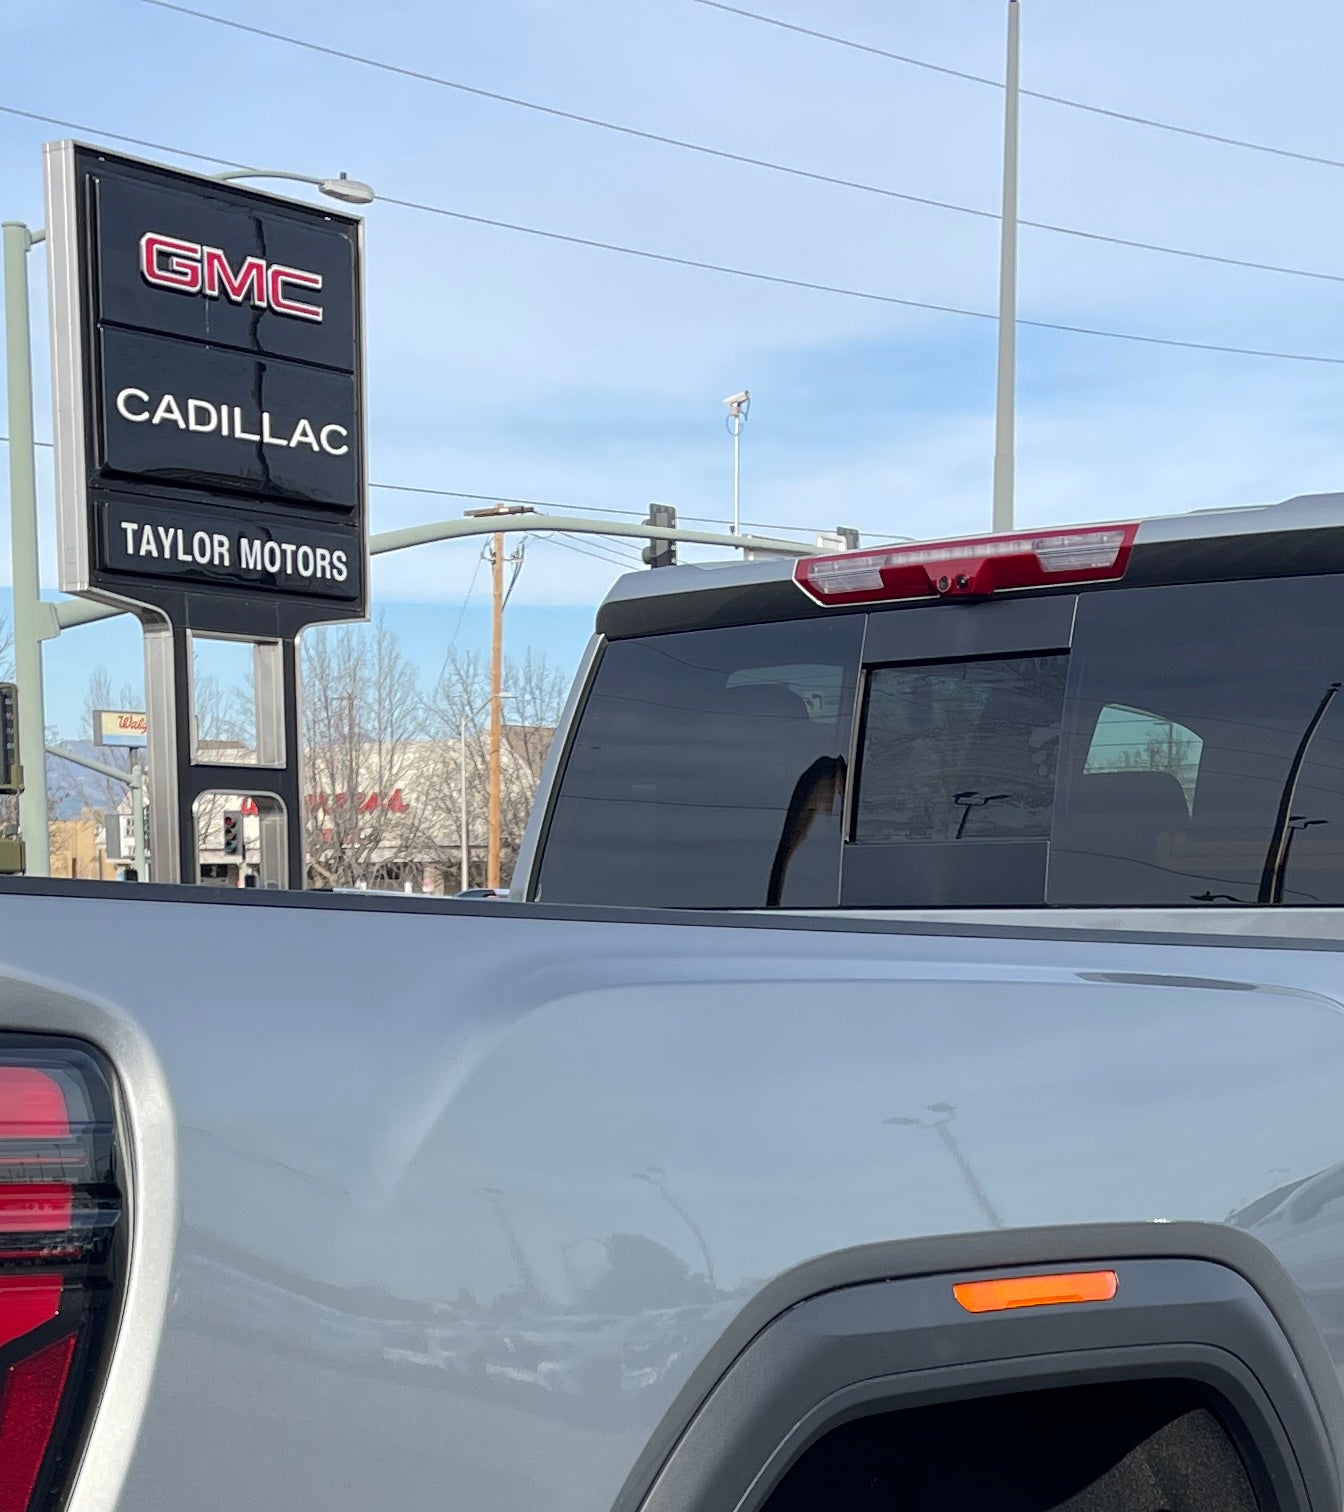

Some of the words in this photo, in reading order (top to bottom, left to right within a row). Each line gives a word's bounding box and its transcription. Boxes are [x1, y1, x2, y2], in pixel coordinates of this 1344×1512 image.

[138, 231, 323, 322] GMC
[116, 387, 349, 456] CADILLAC
[120, 521, 230, 567] TAYLOR
[239, 536, 348, 583] MOTORS
